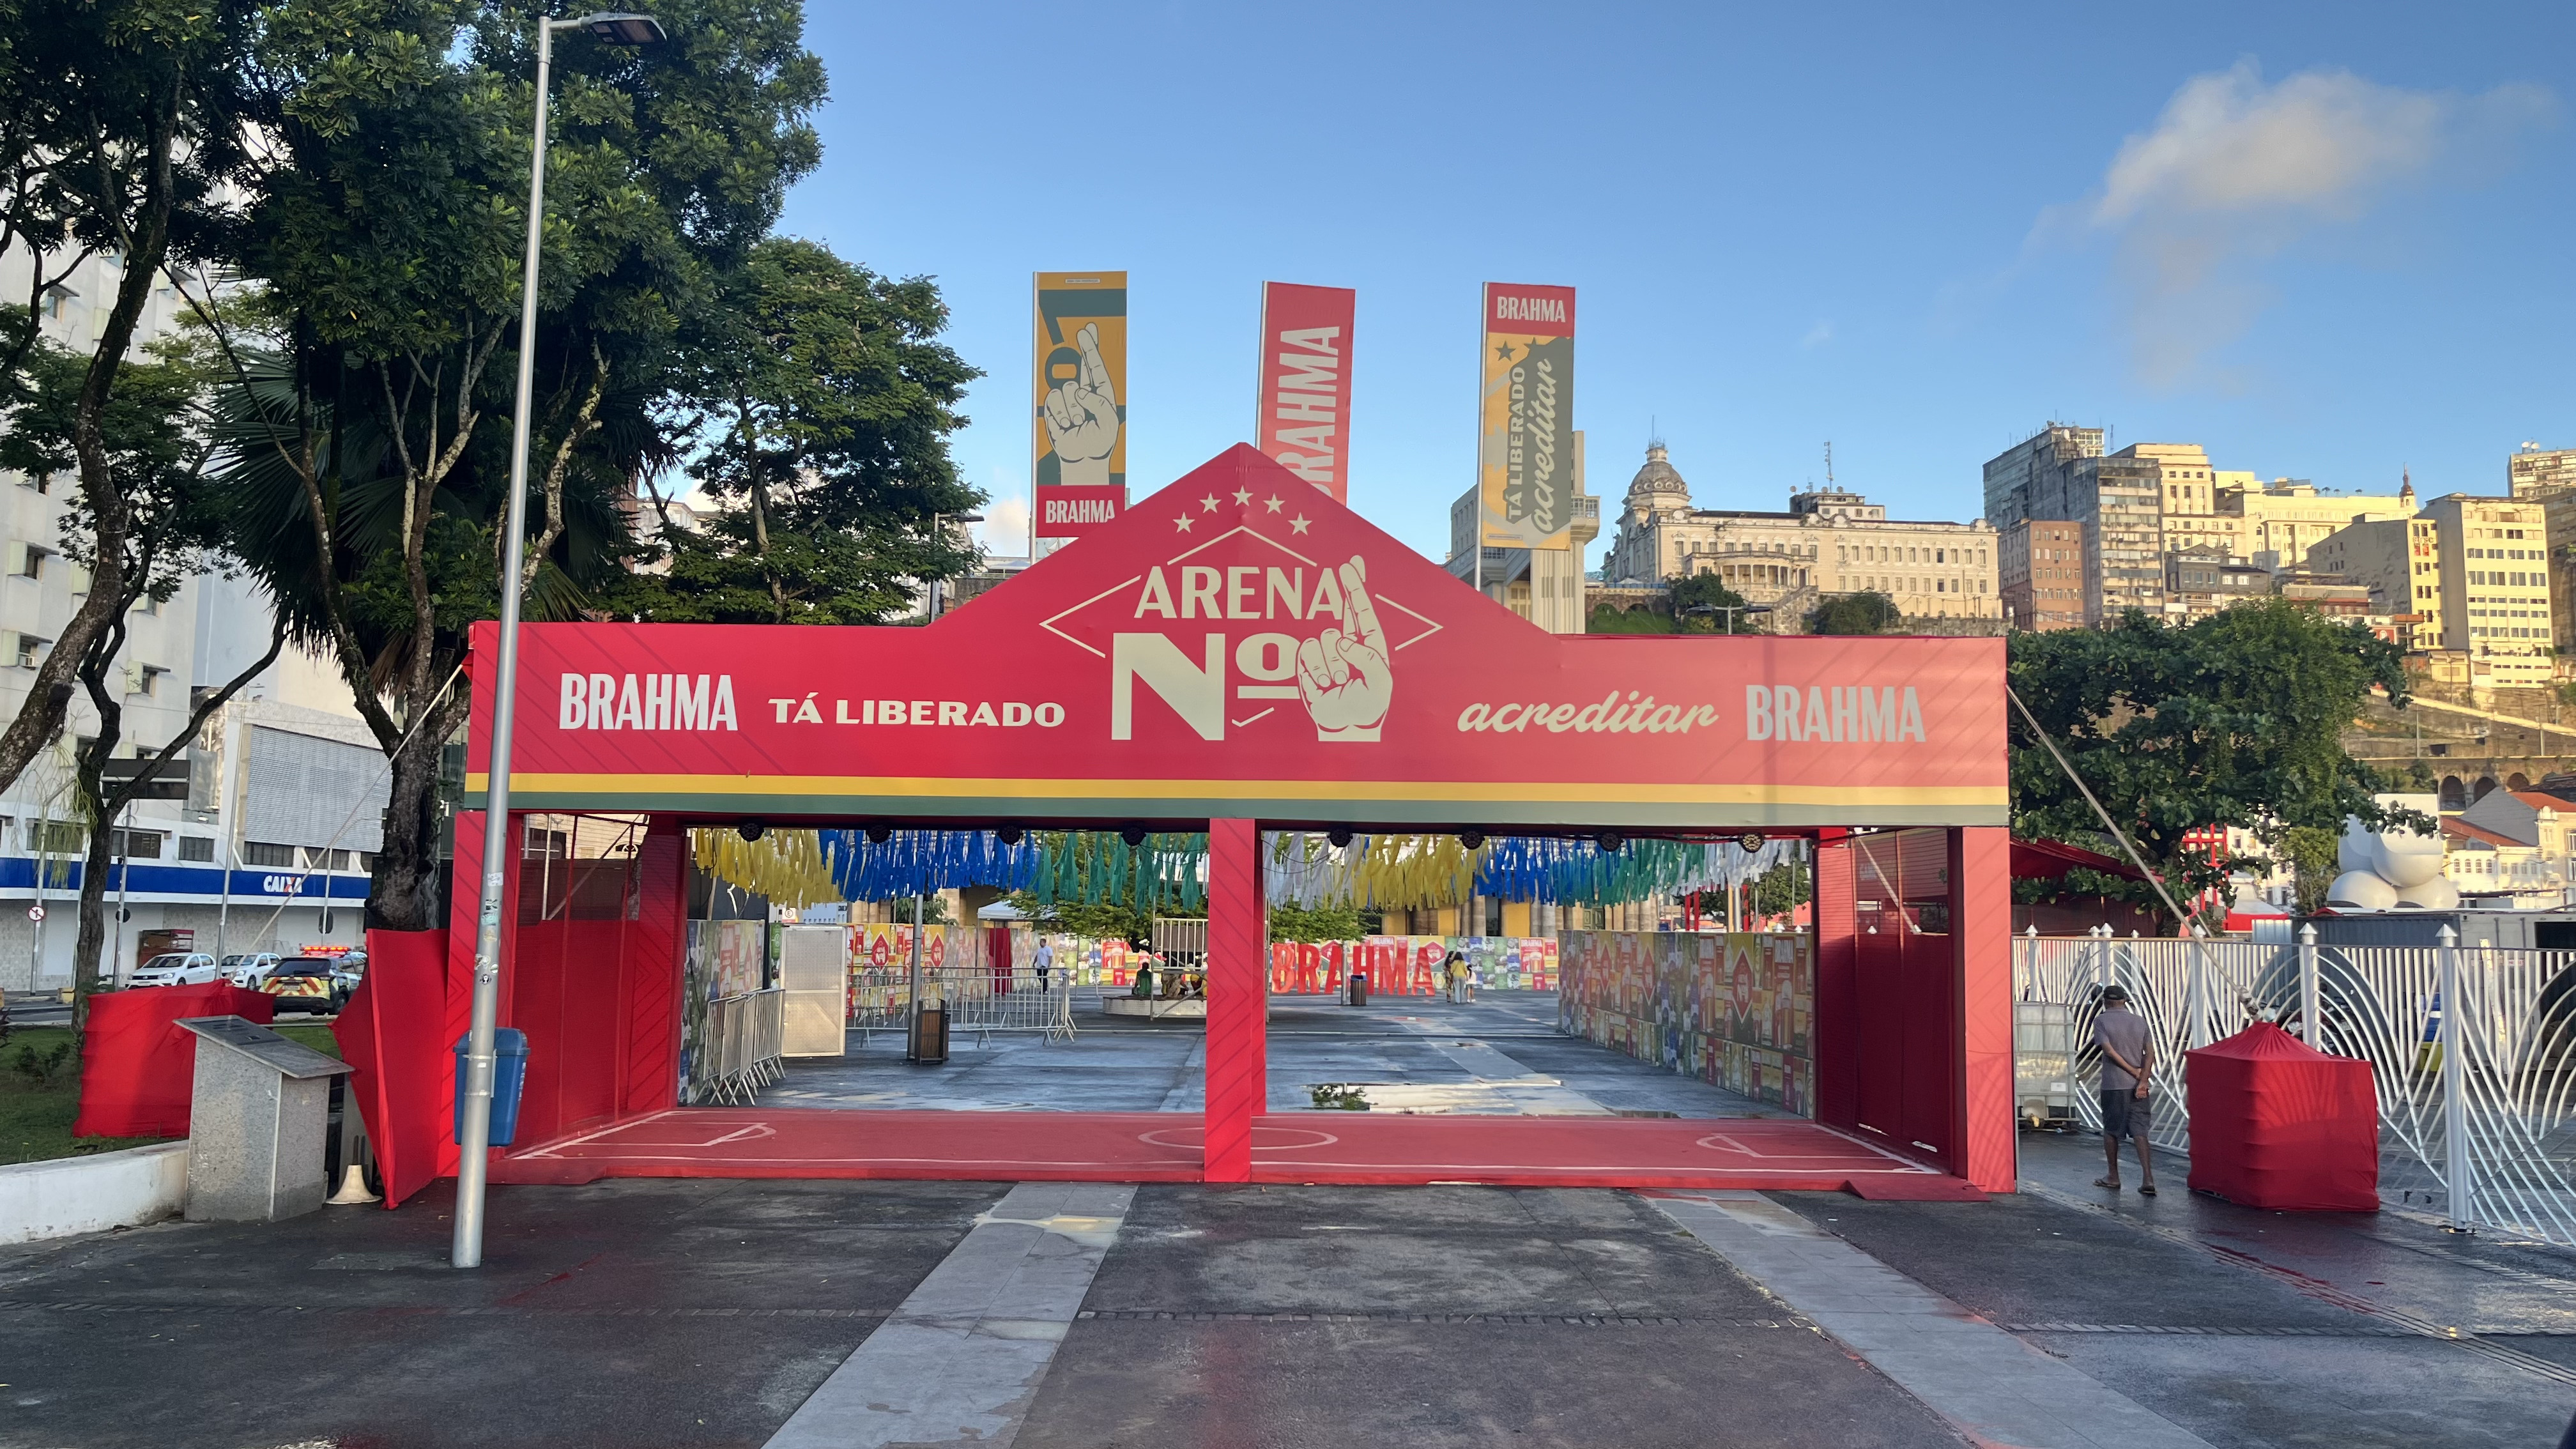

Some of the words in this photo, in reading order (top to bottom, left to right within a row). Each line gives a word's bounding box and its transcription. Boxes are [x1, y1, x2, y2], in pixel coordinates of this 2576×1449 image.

[1497, 296, 1565, 323] BRAHMA
[1275, 326, 1340, 498] RAHMA
[1510, 367, 1526, 486] LIBERADO
[1527, 358, 1556, 532] acreditar
[1046, 500, 1115, 523] BRAHMA
[1505, 496, 1522, 519] TÁ
[1134, 565, 1342, 620] ARENA
[559, 673, 738, 731] BRAHMA
[768, 692, 823, 723] TÁ
[836, 700, 1065, 728] LIBERADO
[1457, 691, 1719, 733] acreditar
[1746, 685, 1926, 742] BRAHMA
[263, 875, 302, 893] CAIXA
[1272, 942, 1436, 996] BRAHMA
